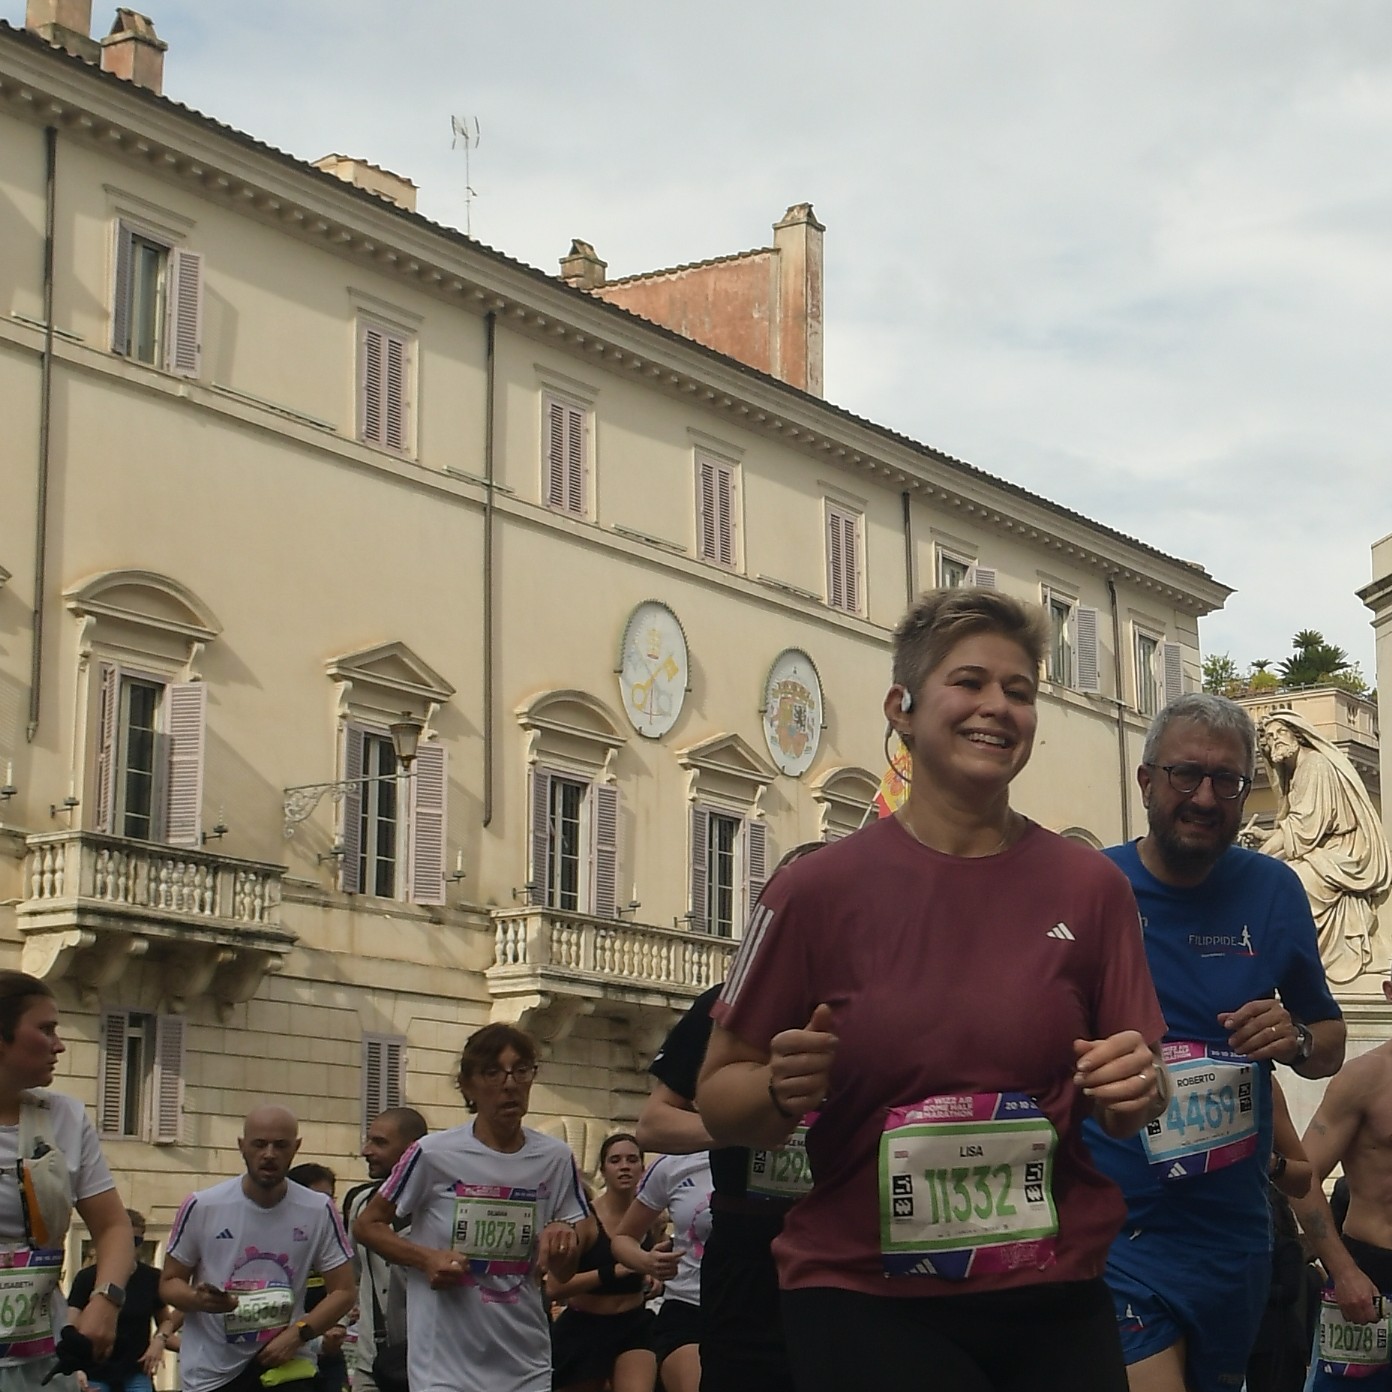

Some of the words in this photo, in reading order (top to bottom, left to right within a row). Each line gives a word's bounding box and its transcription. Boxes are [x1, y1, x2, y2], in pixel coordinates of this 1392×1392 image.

[1188, 934, 1238, 947] FILIPPIDE
[1177, 1073, 1216, 1088] ROBERTO
[1166, 1085, 1236, 1136] 4469
[960, 1146, 984, 1158] LISA
[925, 1164, 1017, 1225] 11332
[473, 1220, 516, 1249] 11873
[1329, 1323, 1372, 1353] 12078
